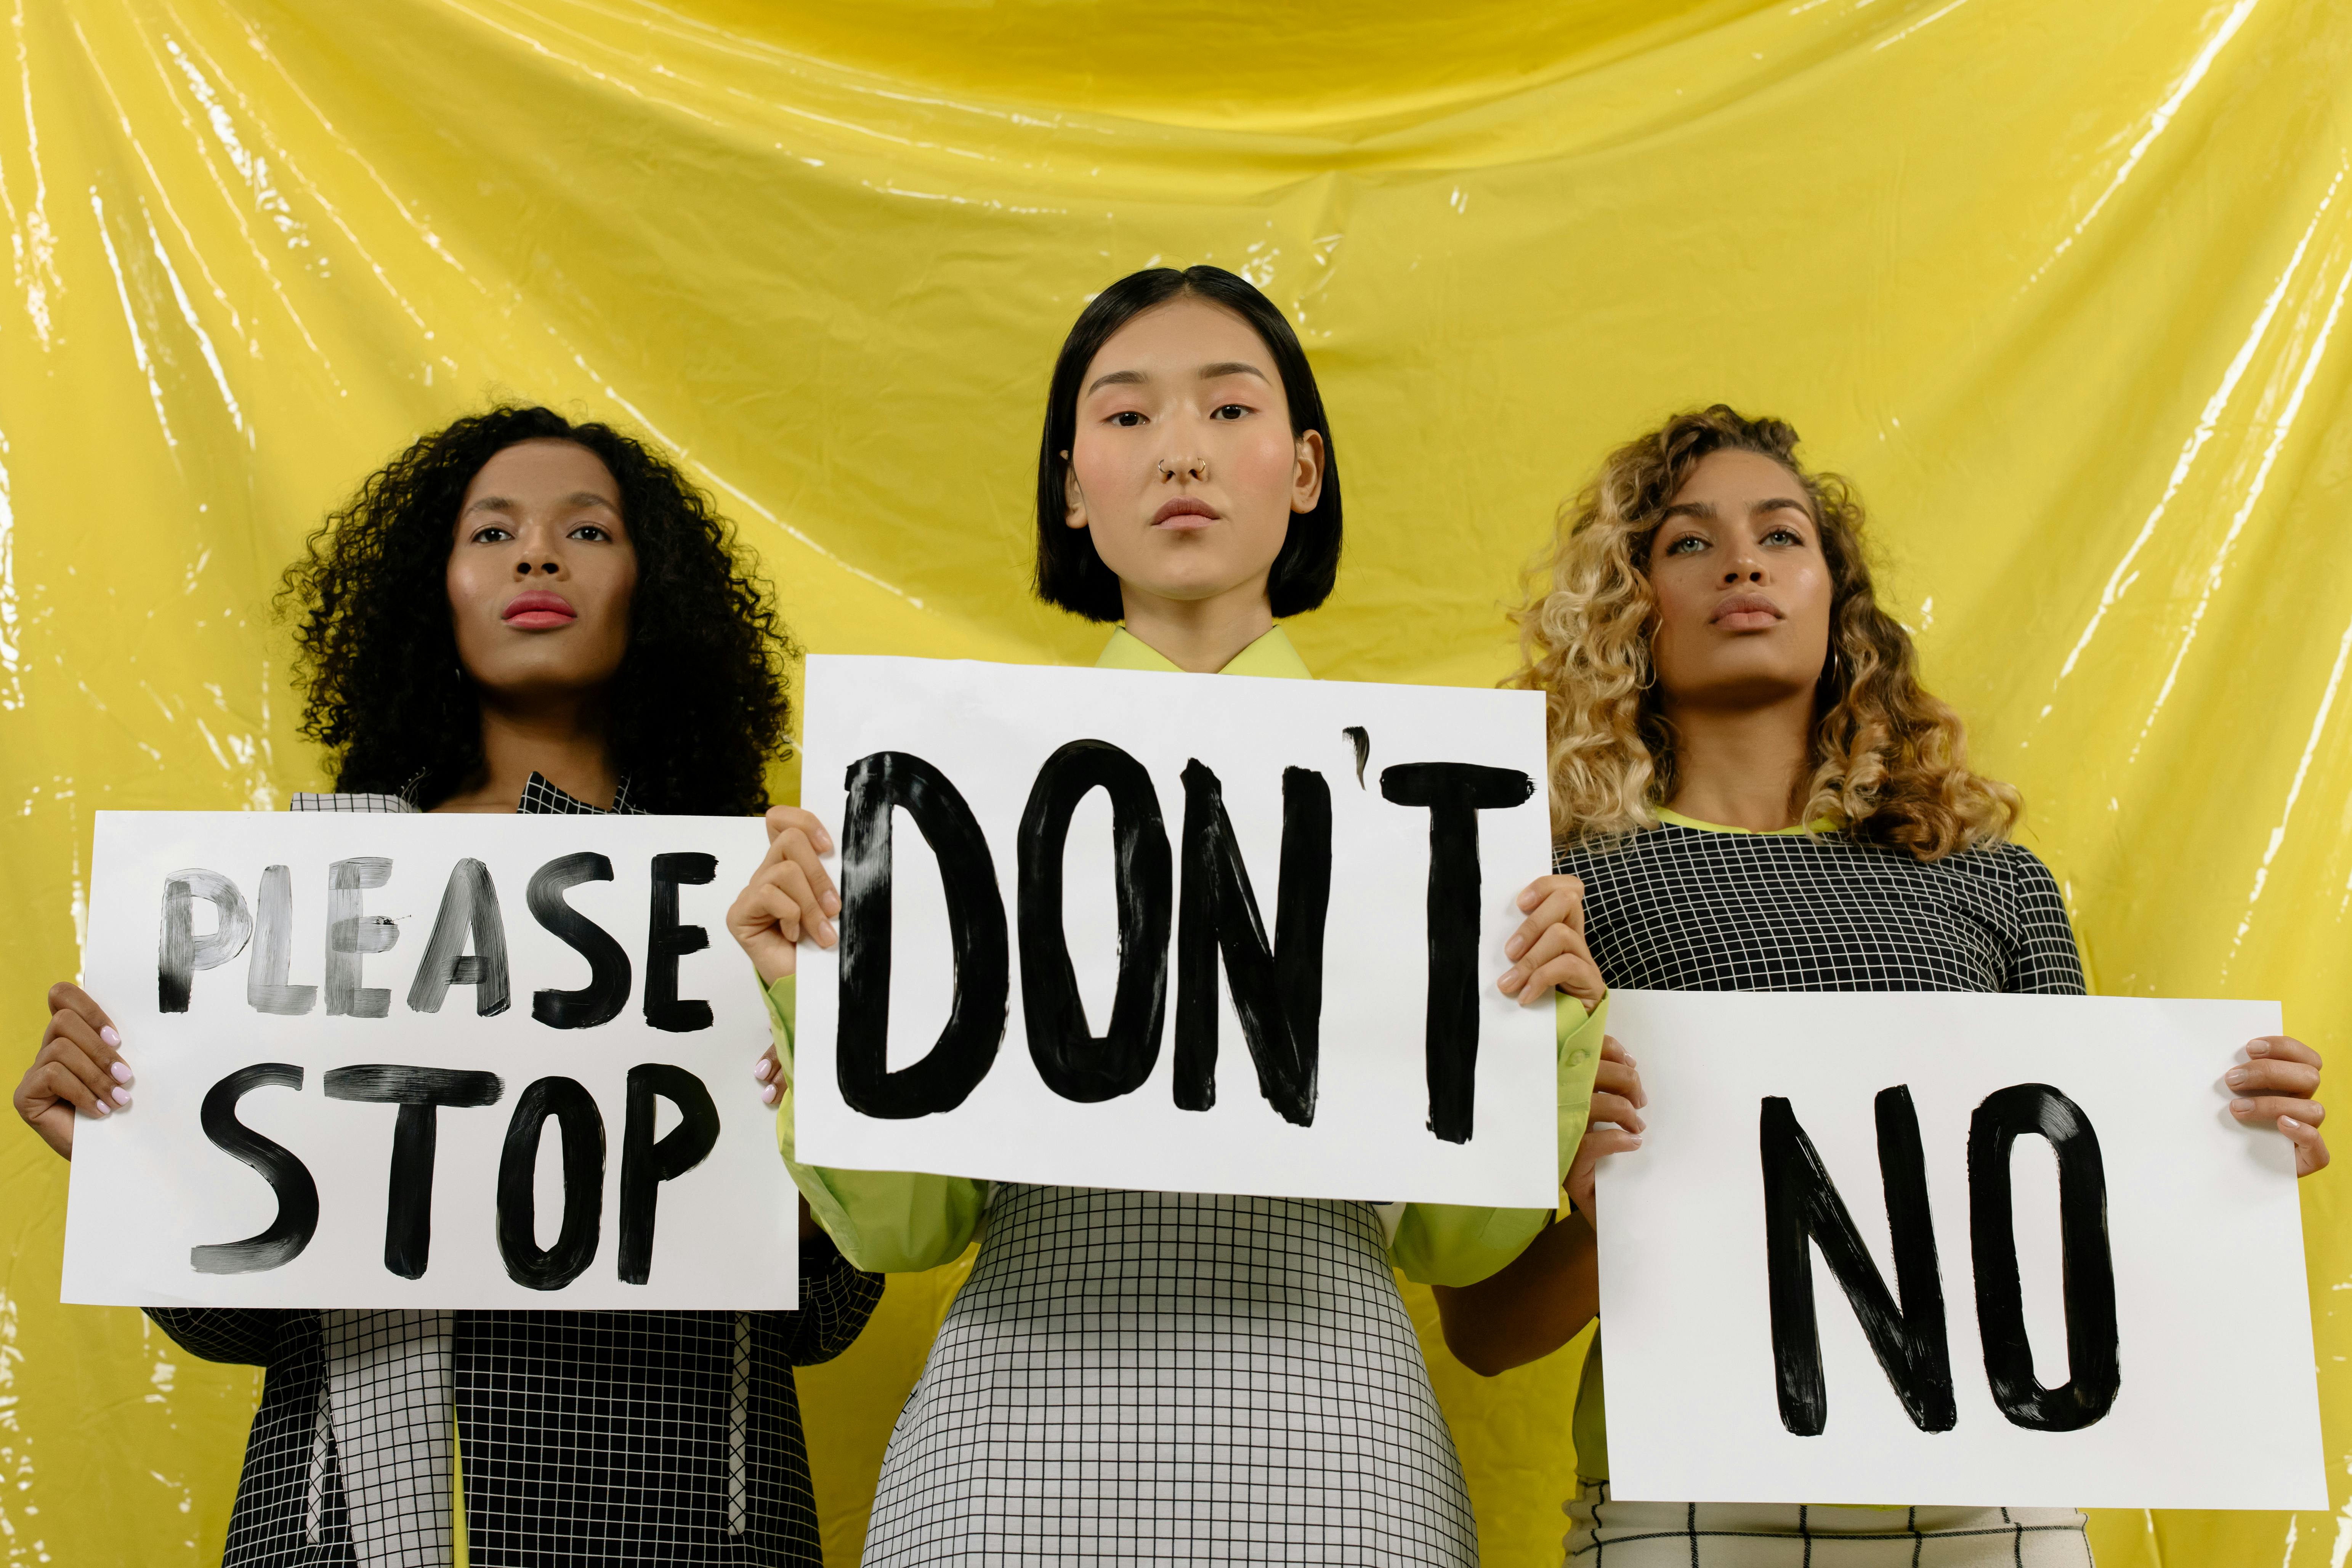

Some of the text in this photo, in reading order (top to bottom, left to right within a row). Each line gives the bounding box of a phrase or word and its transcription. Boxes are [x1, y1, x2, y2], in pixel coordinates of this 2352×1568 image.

[158, 852, 719, 1033] PLEASE
[836, 726, 1536, 1145] DON'T
[190, 1063, 720, 1291] STOP
[1760, 1083, 2121, 1437] NO
